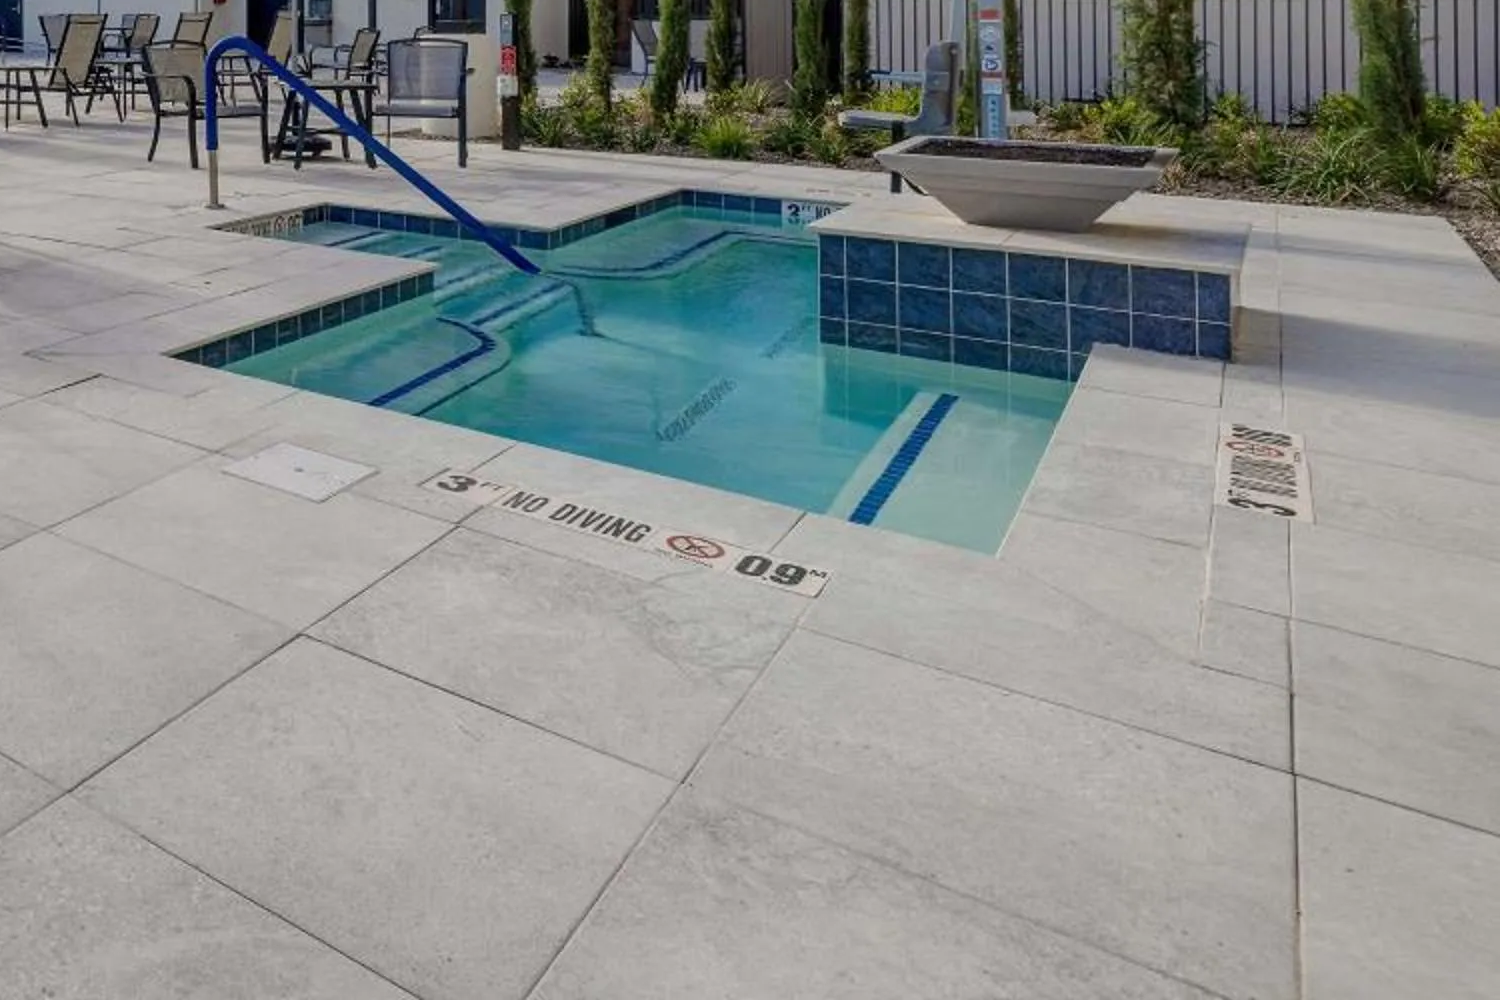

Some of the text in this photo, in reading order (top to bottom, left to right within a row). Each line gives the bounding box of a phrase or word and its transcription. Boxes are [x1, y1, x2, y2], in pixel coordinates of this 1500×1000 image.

[437, 475, 477, 493] 3
[502, 490, 550, 513] NO
[548, 503, 652, 543] DIVING
[735, 555, 807, 586] 0.9
